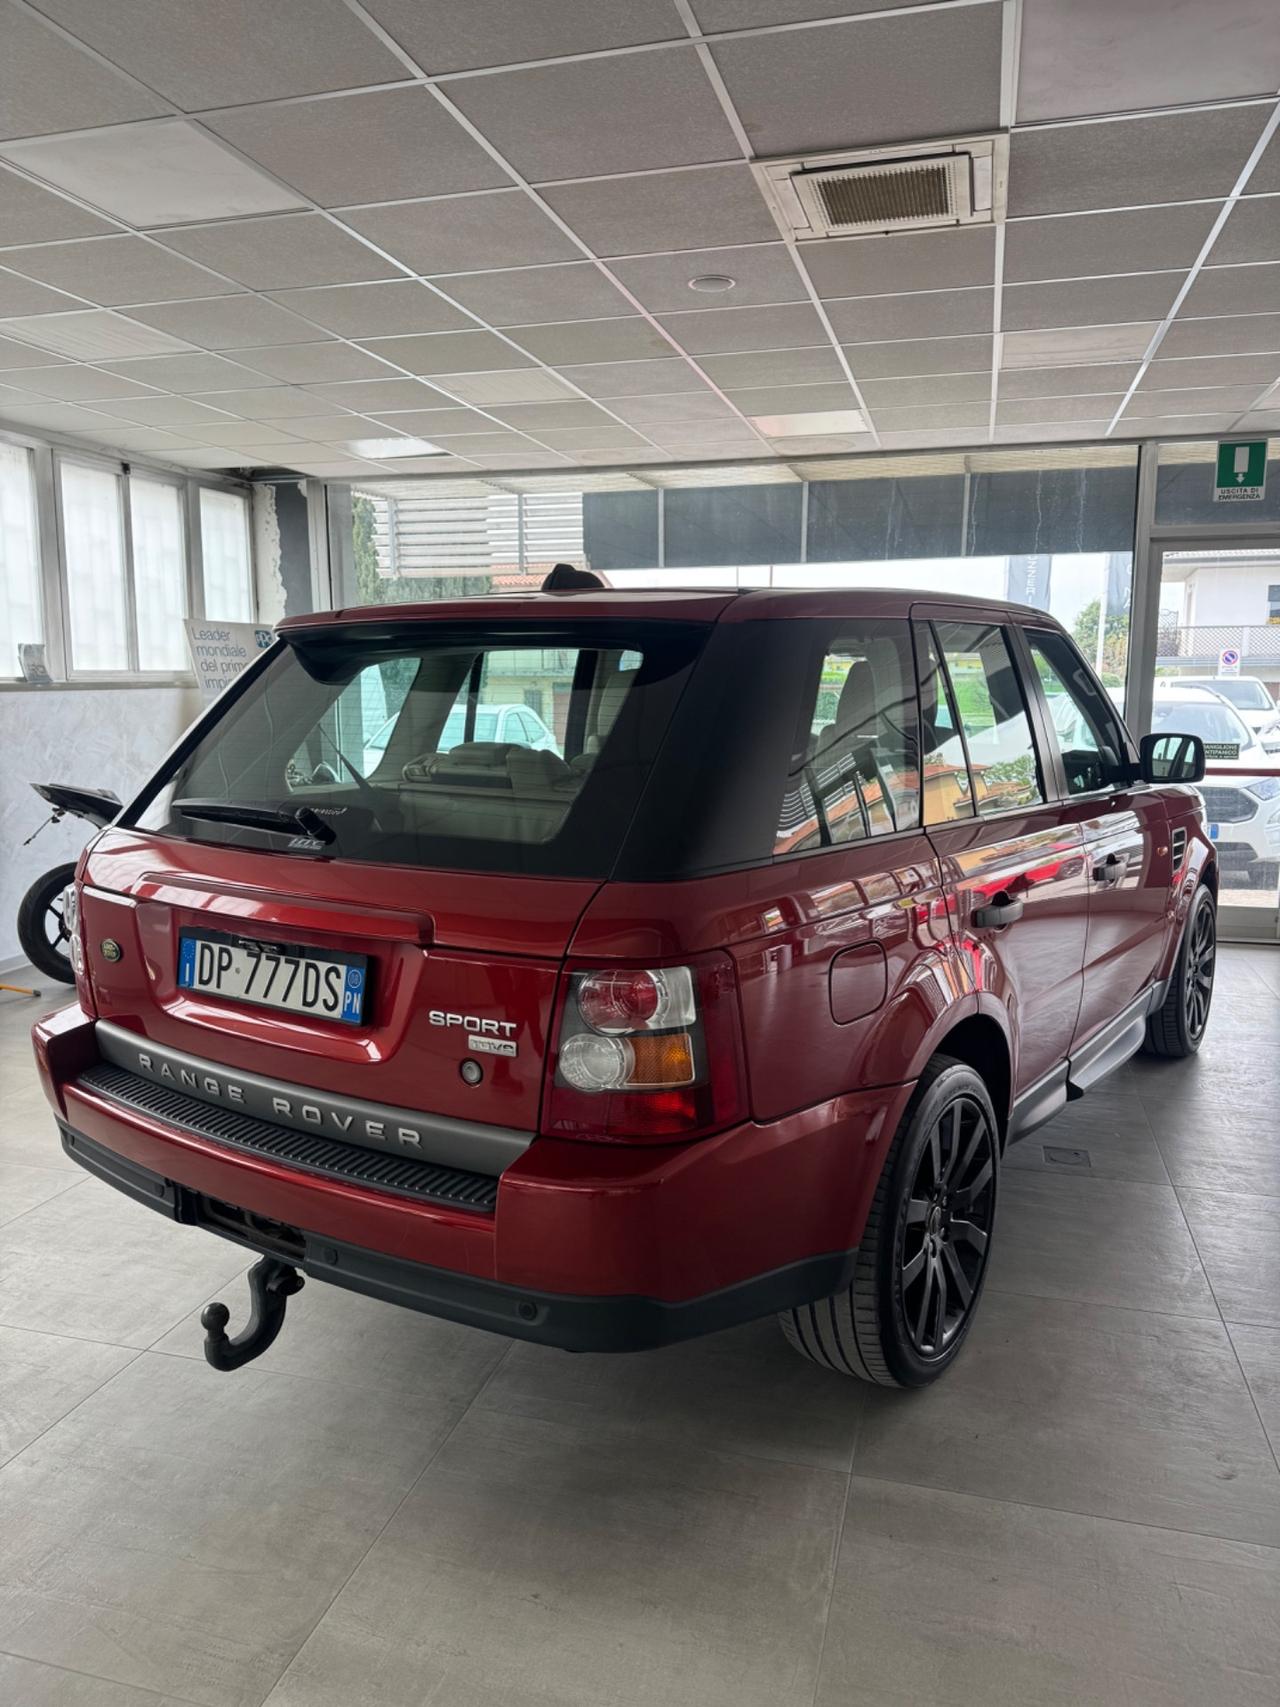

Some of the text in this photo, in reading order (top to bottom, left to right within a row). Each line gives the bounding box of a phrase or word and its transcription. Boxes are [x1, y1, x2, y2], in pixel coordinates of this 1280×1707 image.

[191, 625, 230, 641] Leader
[196, 643, 247, 657] mondiale
[201, 659, 219, 673] del
[198, 943, 342, 1012] DP 777DS
[343, 991, 362, 1015] PN
[428, 1010, 517, 1037] SPORT
[138, 1053, 423, 1148] RANGE ROVER
